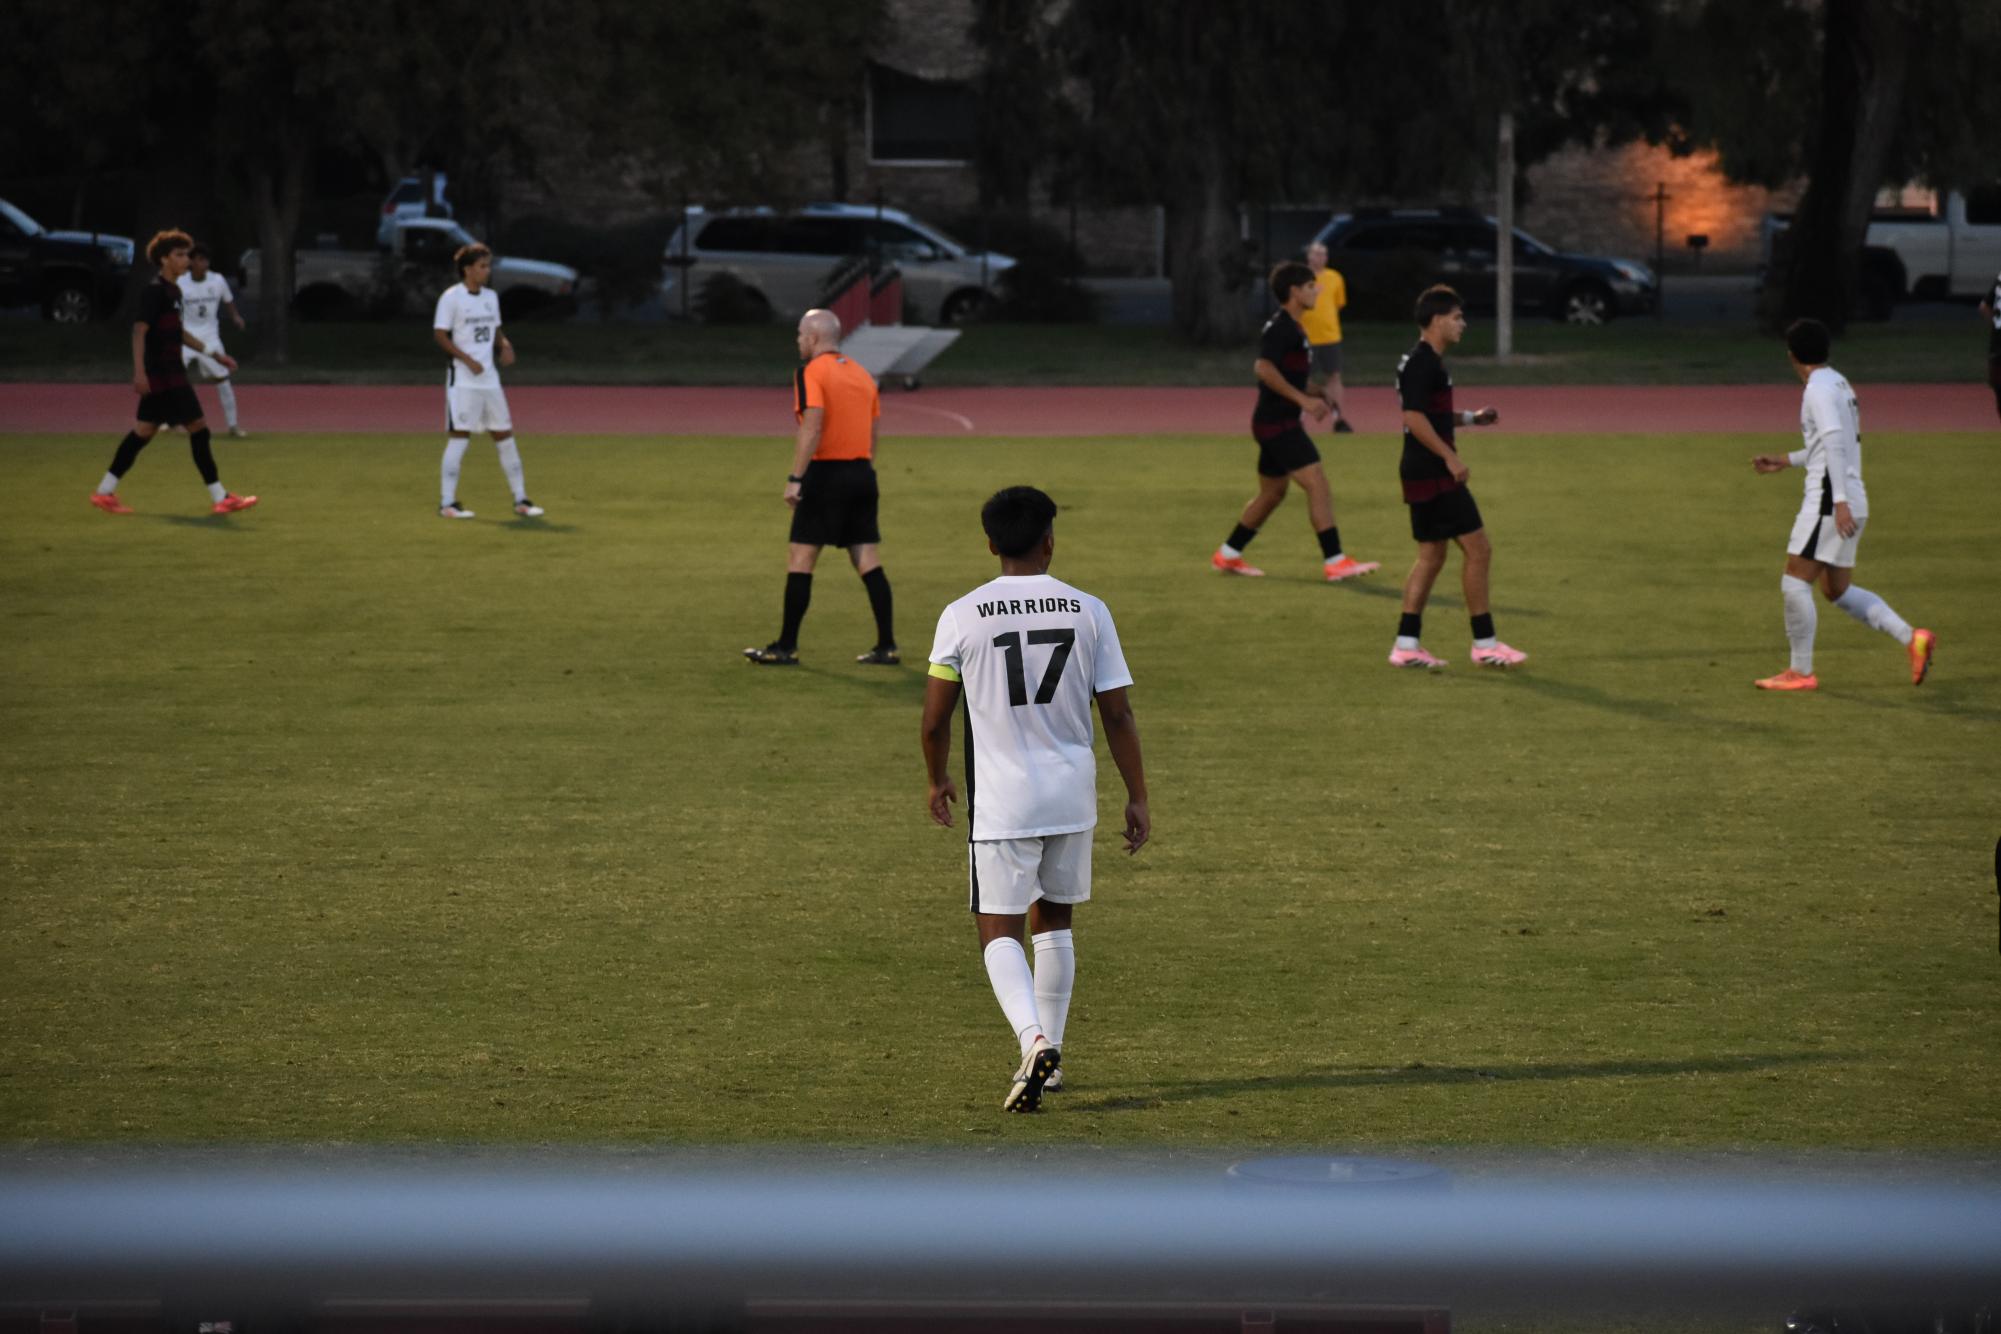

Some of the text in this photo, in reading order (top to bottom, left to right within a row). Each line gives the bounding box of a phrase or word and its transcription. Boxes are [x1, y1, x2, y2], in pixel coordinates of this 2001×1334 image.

[474, 326, 490, 343] 20
[977, 598, 1081, 618] WARRIORS
[993, 628, 1076, 707] 17
